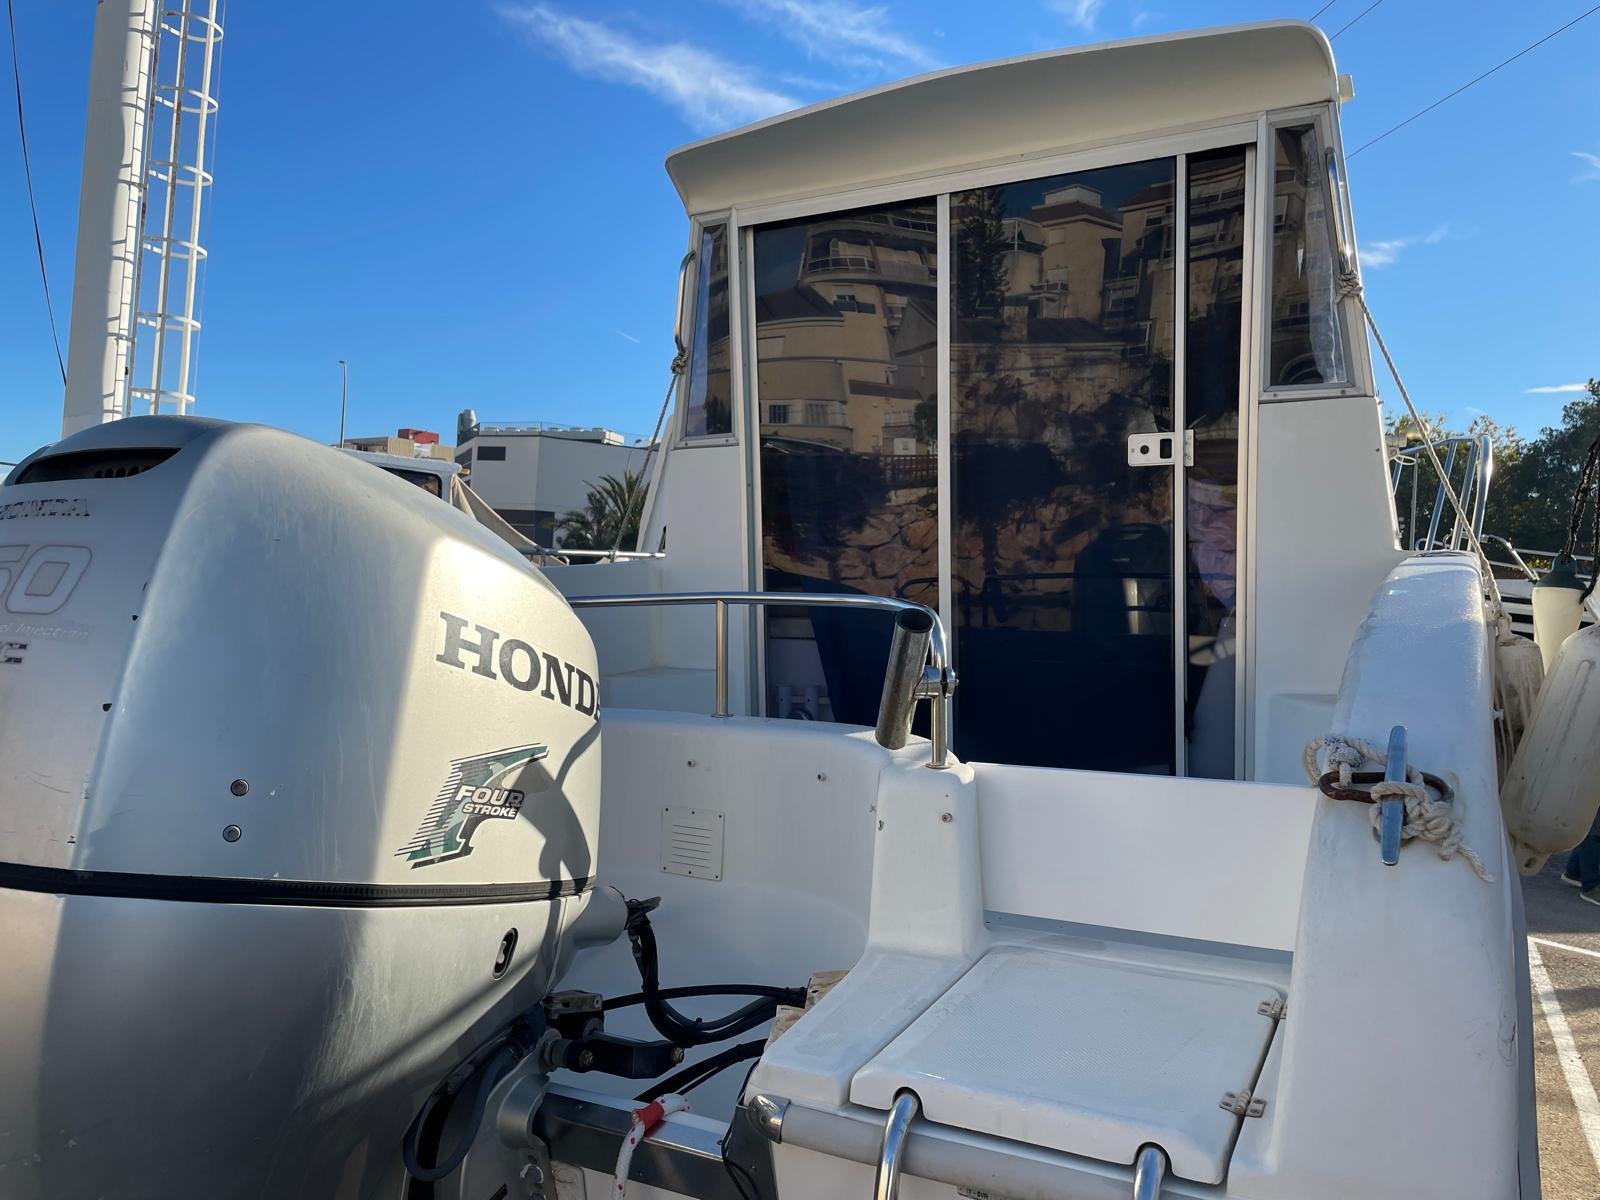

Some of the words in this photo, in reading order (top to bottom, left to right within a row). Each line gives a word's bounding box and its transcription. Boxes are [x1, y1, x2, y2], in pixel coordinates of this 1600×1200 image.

[435, 610, 600, 722] HOND
[455, 784, 524, 808] FOUR
[462, 803, 518, 818] STROKE
